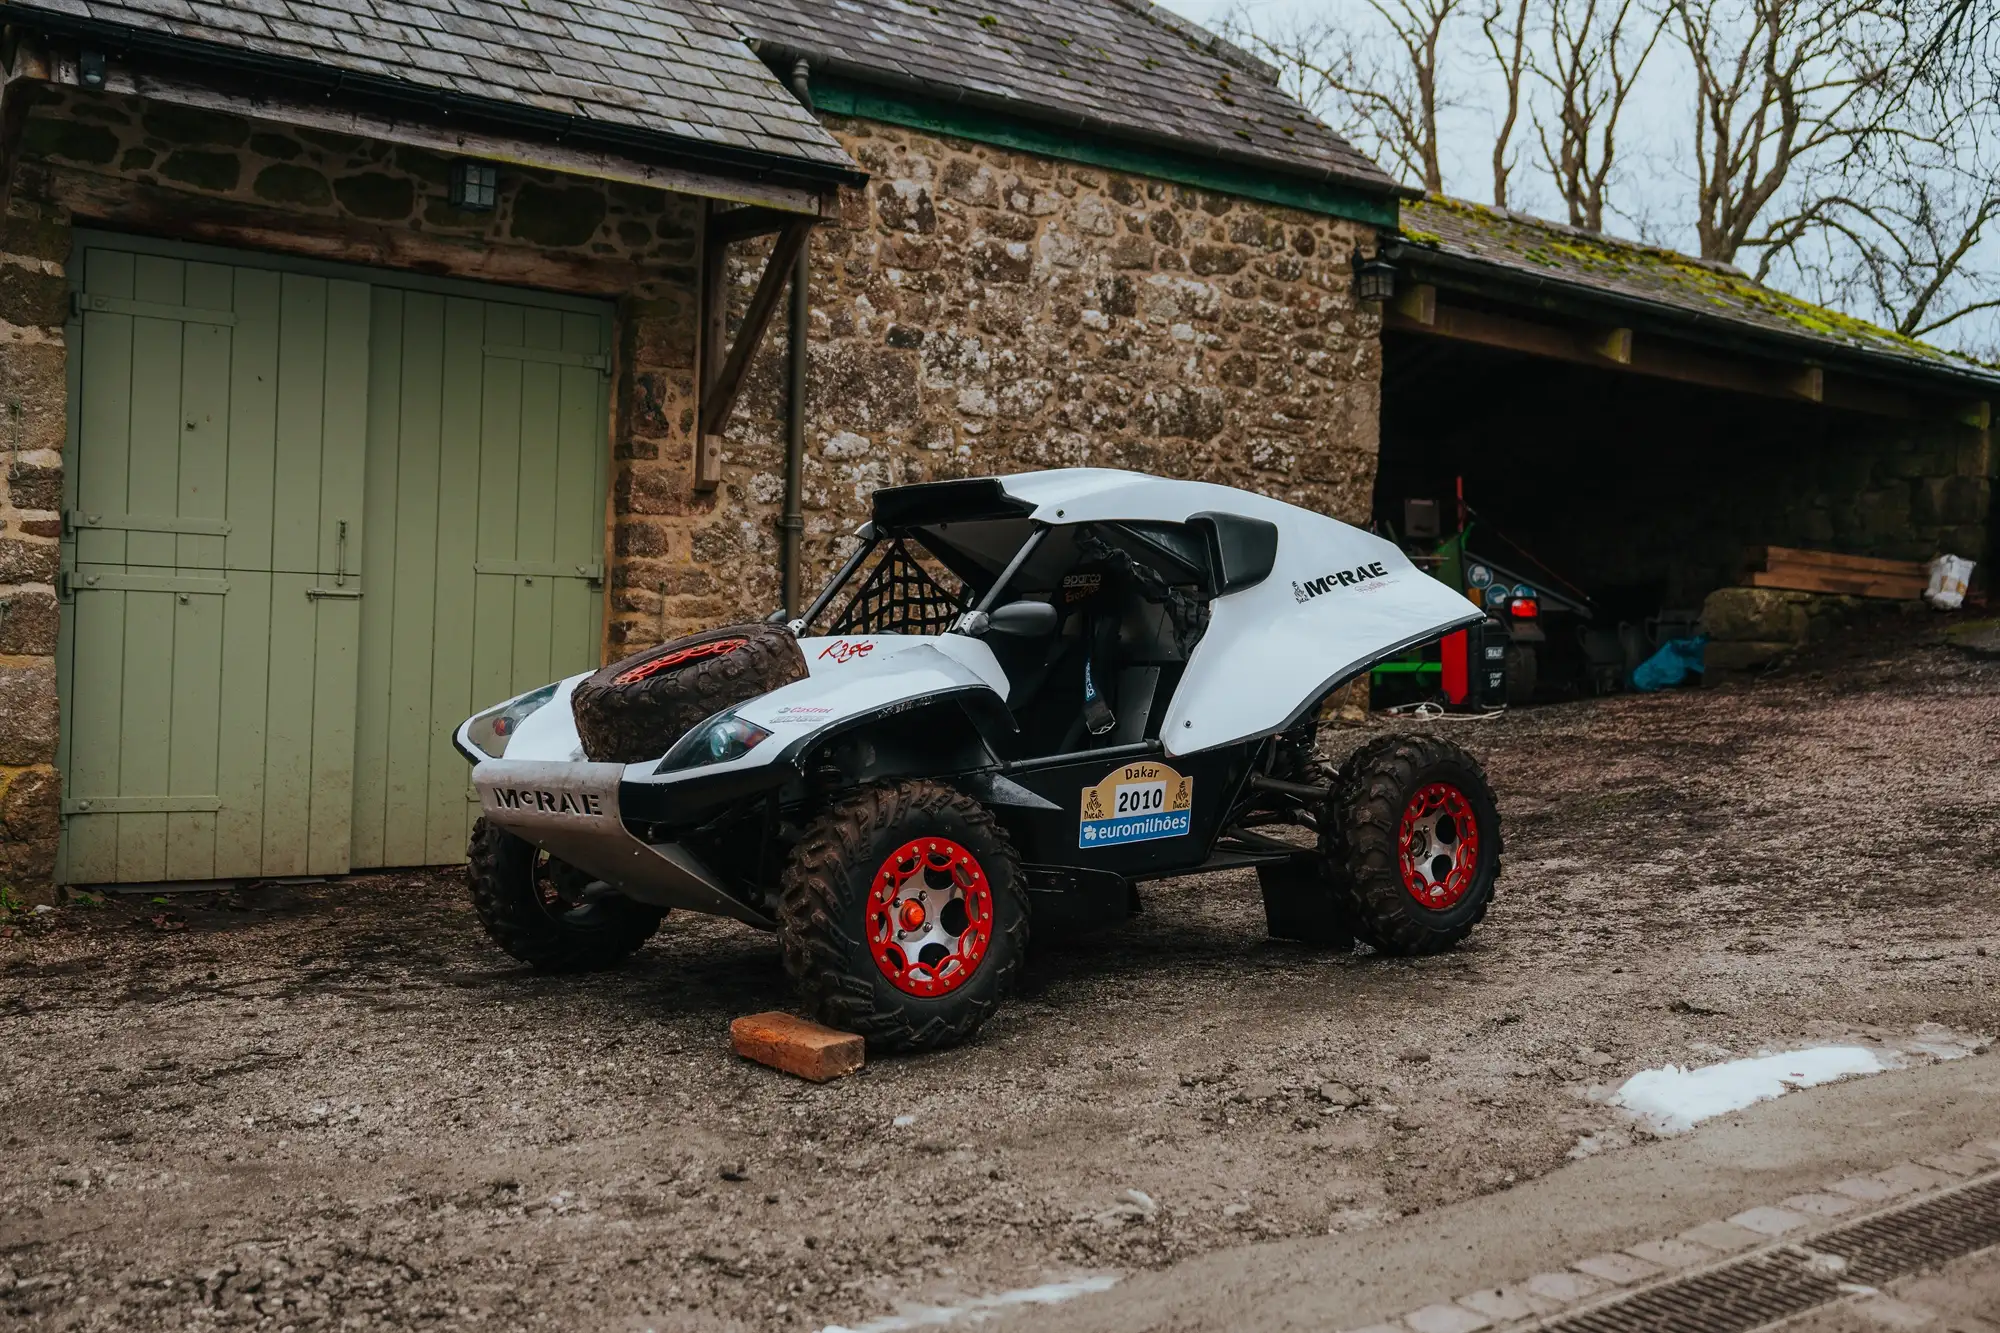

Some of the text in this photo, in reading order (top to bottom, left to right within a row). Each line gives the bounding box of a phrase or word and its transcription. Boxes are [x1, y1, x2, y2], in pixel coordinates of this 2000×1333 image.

[1063, 573, 1101, 588] sparco
[818, 639, 874, 663] Rage
[1125, 766, 1160, 780] Dakar
[1118, 788, 1163, 813] 2010
